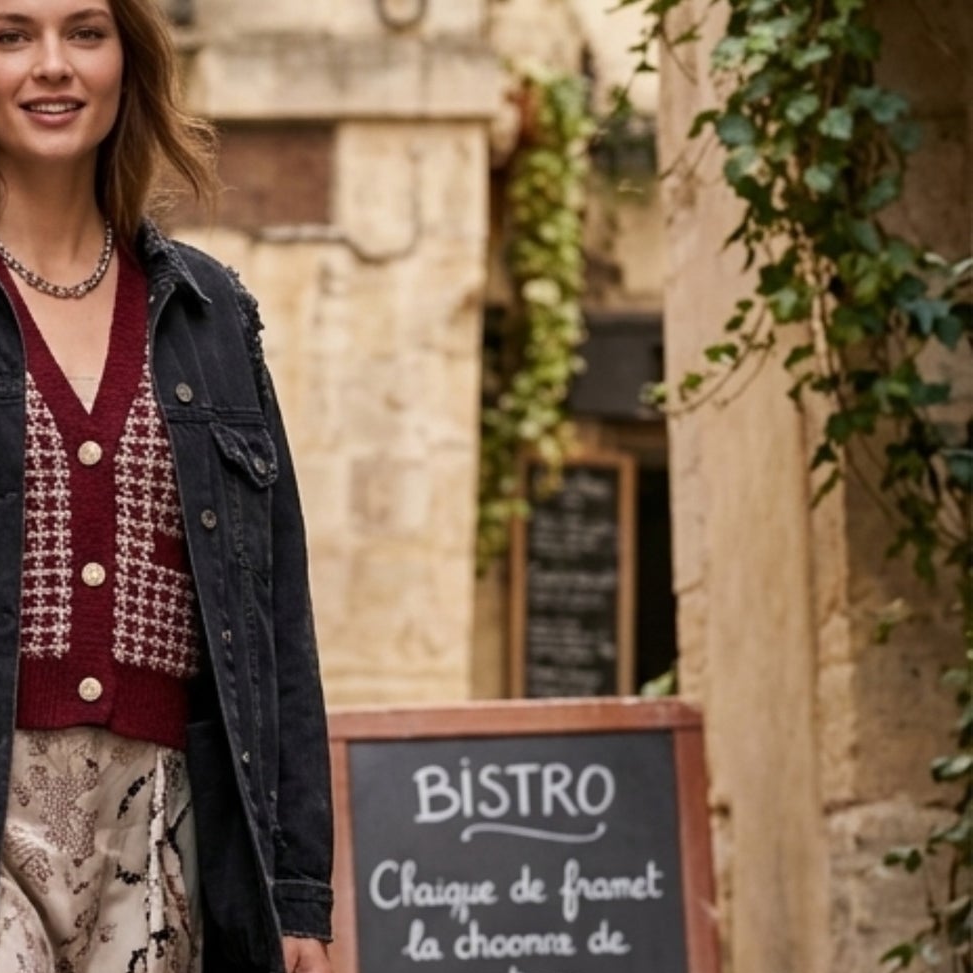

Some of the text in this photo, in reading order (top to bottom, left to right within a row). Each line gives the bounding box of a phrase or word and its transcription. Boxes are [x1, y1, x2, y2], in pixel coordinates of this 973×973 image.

[509, 865, 547, 903] de
[403, 919, 443, 961] la
[587, 920, 630, 954] de
